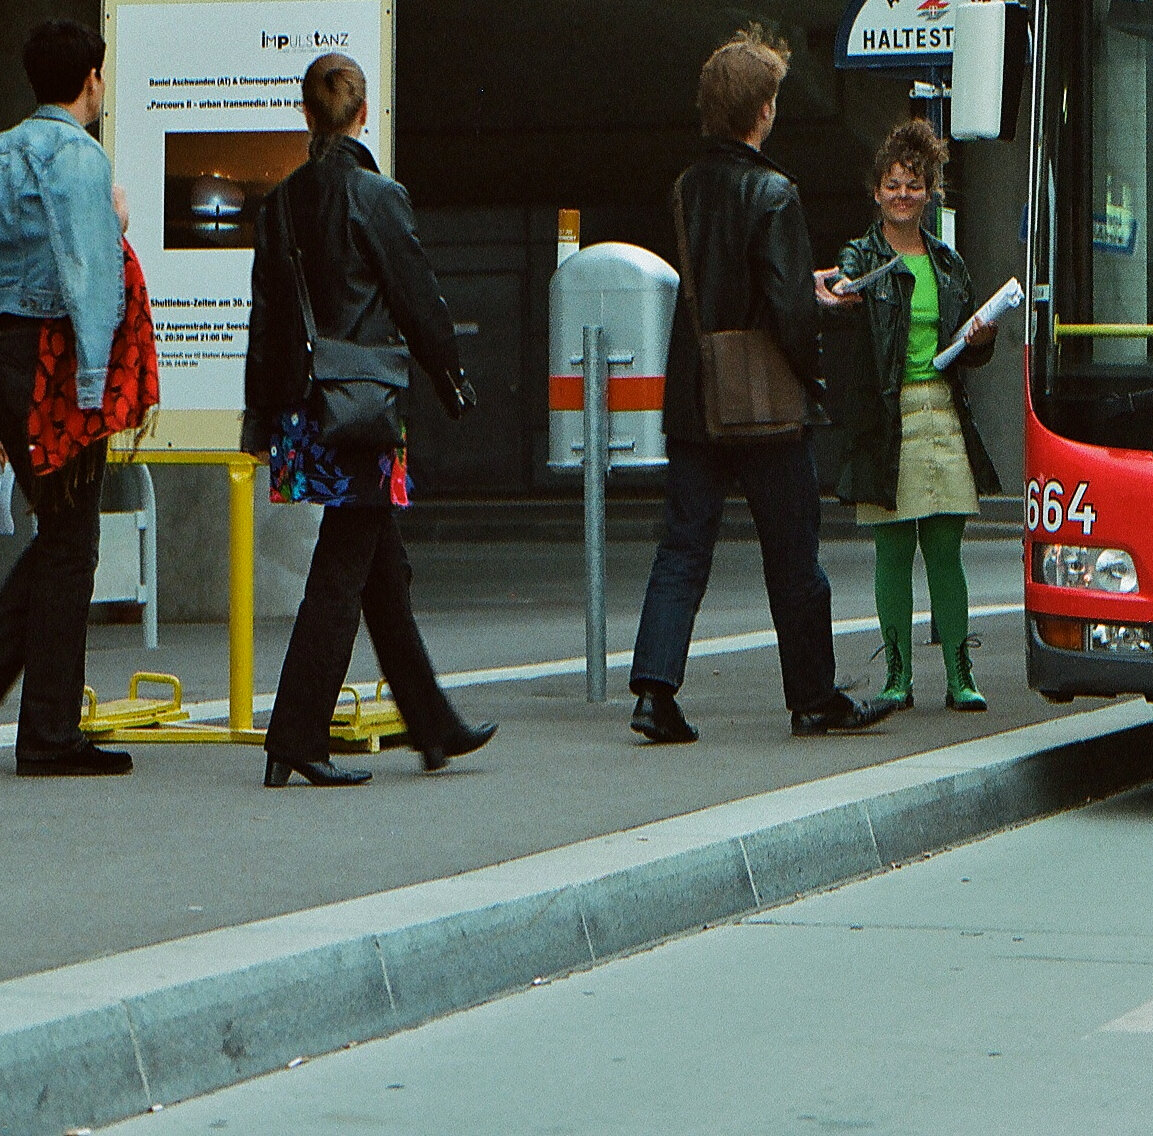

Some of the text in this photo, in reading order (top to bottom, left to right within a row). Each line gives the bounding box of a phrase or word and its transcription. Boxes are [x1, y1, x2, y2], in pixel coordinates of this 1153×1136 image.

[149, 77, 171, 87] Daniel
[199, 99, 222, 109] urban
[270, 98, 282, 108] lab
[284, 98, 292, 108] in
[218, 299, 231, 308] am
[185, 332, 198, 342] und
[221, 332, 233, 342] Uhr
[1027, 479, 1097, 536] 664
